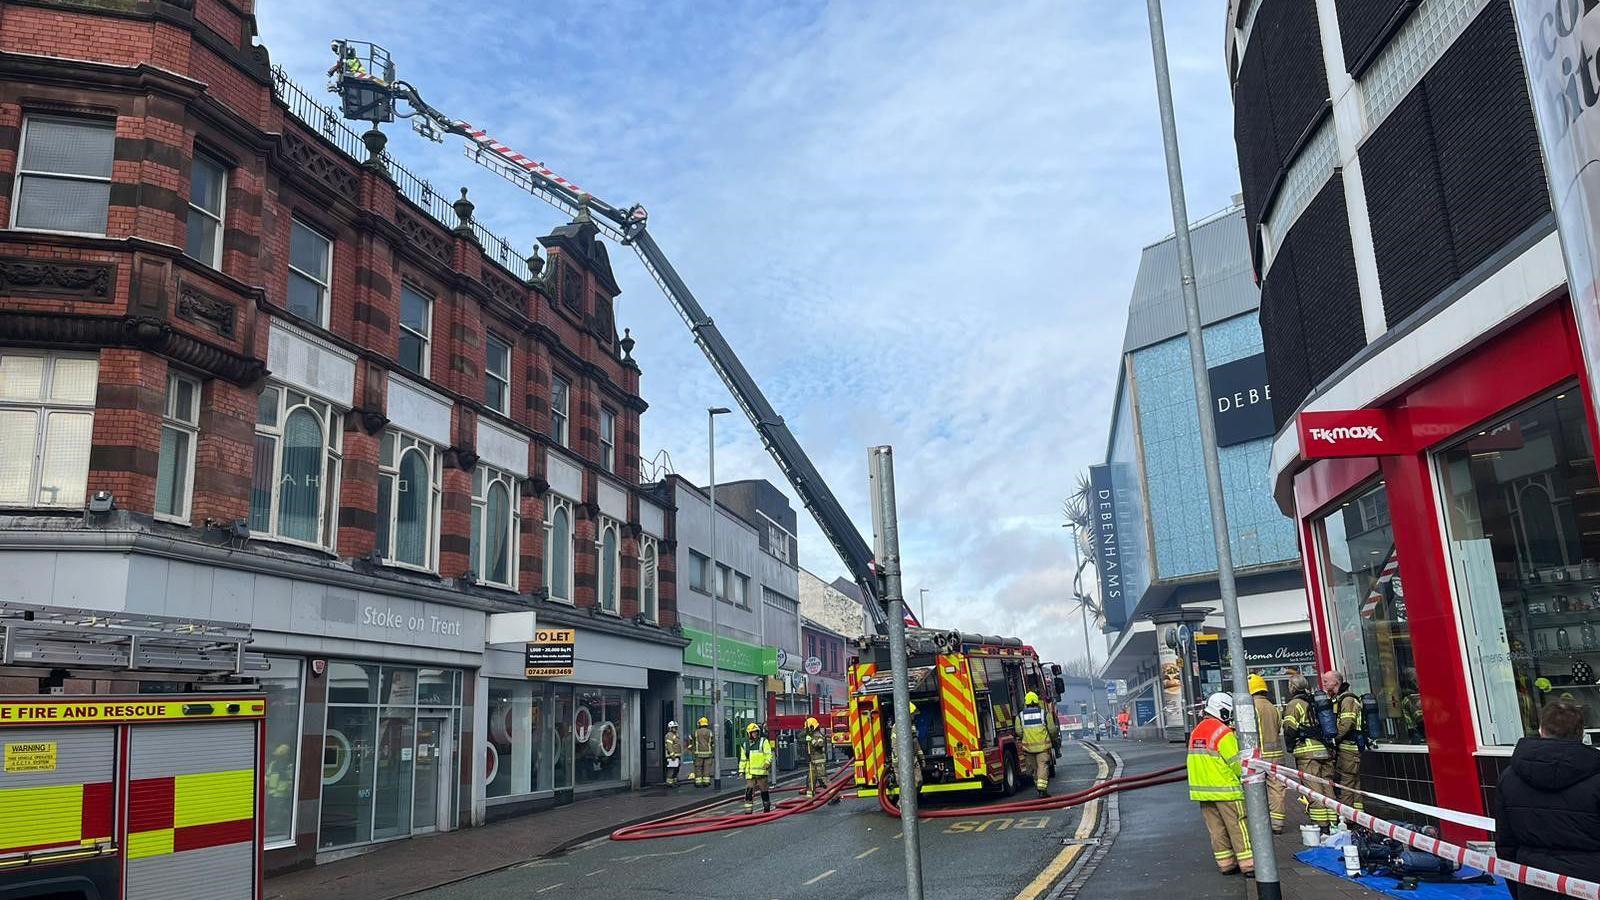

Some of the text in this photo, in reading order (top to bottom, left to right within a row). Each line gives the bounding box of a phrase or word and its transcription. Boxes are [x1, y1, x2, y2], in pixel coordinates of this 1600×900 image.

[1098, 489, 1121, 598] DEBENHAMS
[363, 606, 461, 636] Stoke on Trent
[550, 632, 570, 641] LET
[1, 705, 166, 719] E FIRE AND RESCUE
[12, 743, 46, 752] WARNING
[941, 815, 1052, 835] BUS
